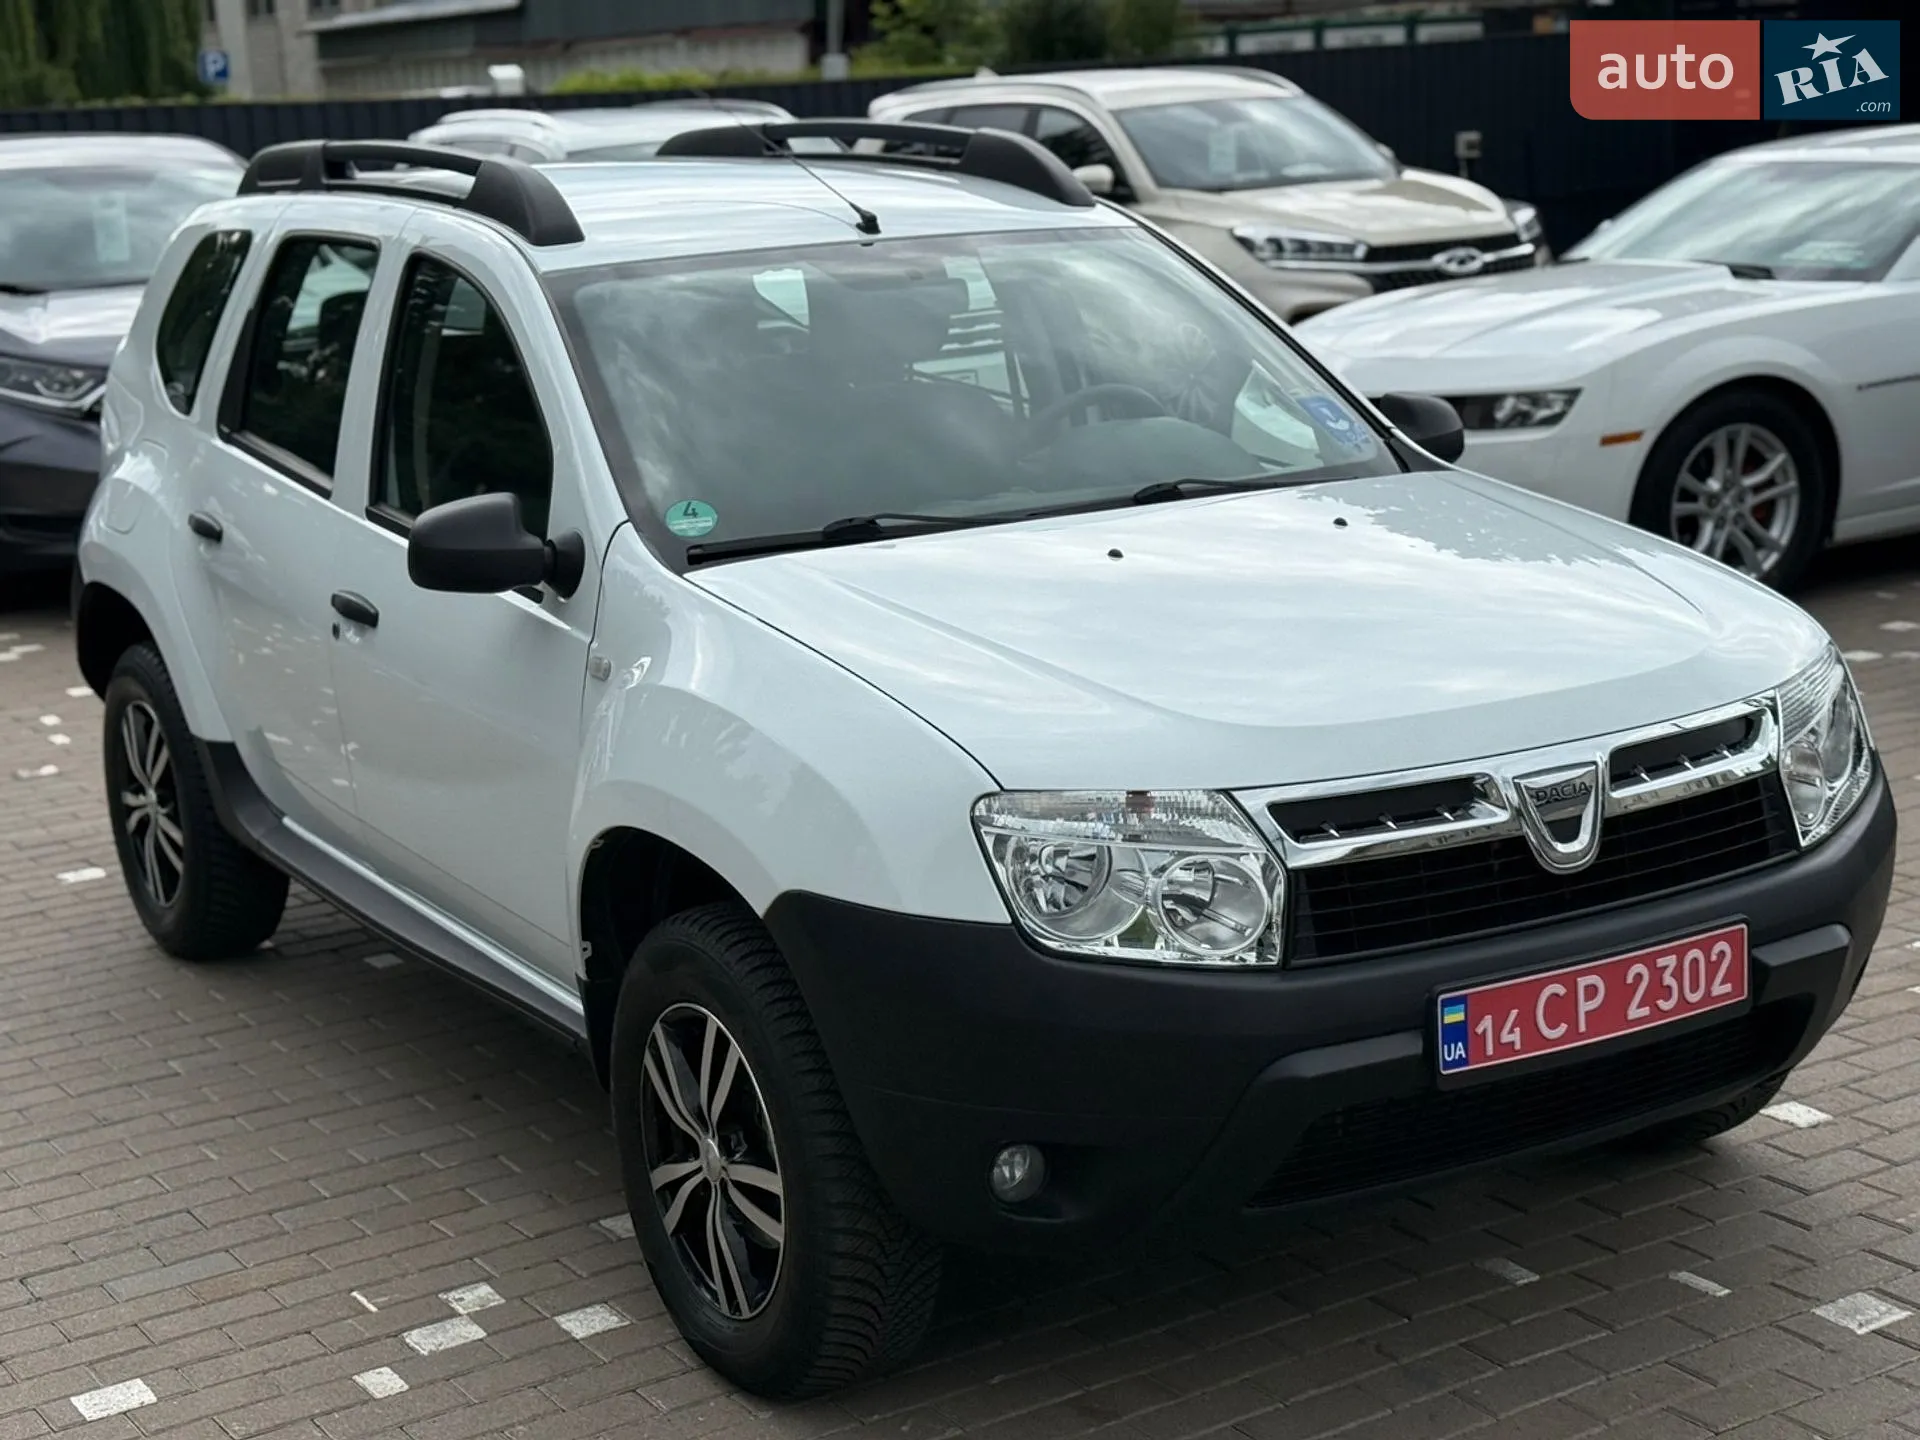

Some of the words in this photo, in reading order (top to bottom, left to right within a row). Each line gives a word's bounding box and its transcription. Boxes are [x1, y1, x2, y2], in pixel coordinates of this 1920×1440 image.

[204, 51, 225, 81] P
[682, 501, 699, 518] 4
[1535, 781, 1591, 805] DACIA
[1475, 1008, 1521, 1056] 14
[1535, 974, 1606, 1040] CP
[1626, 941, 1733, 1020] 2302
[1443, 1042, 1466, 1062] UA
